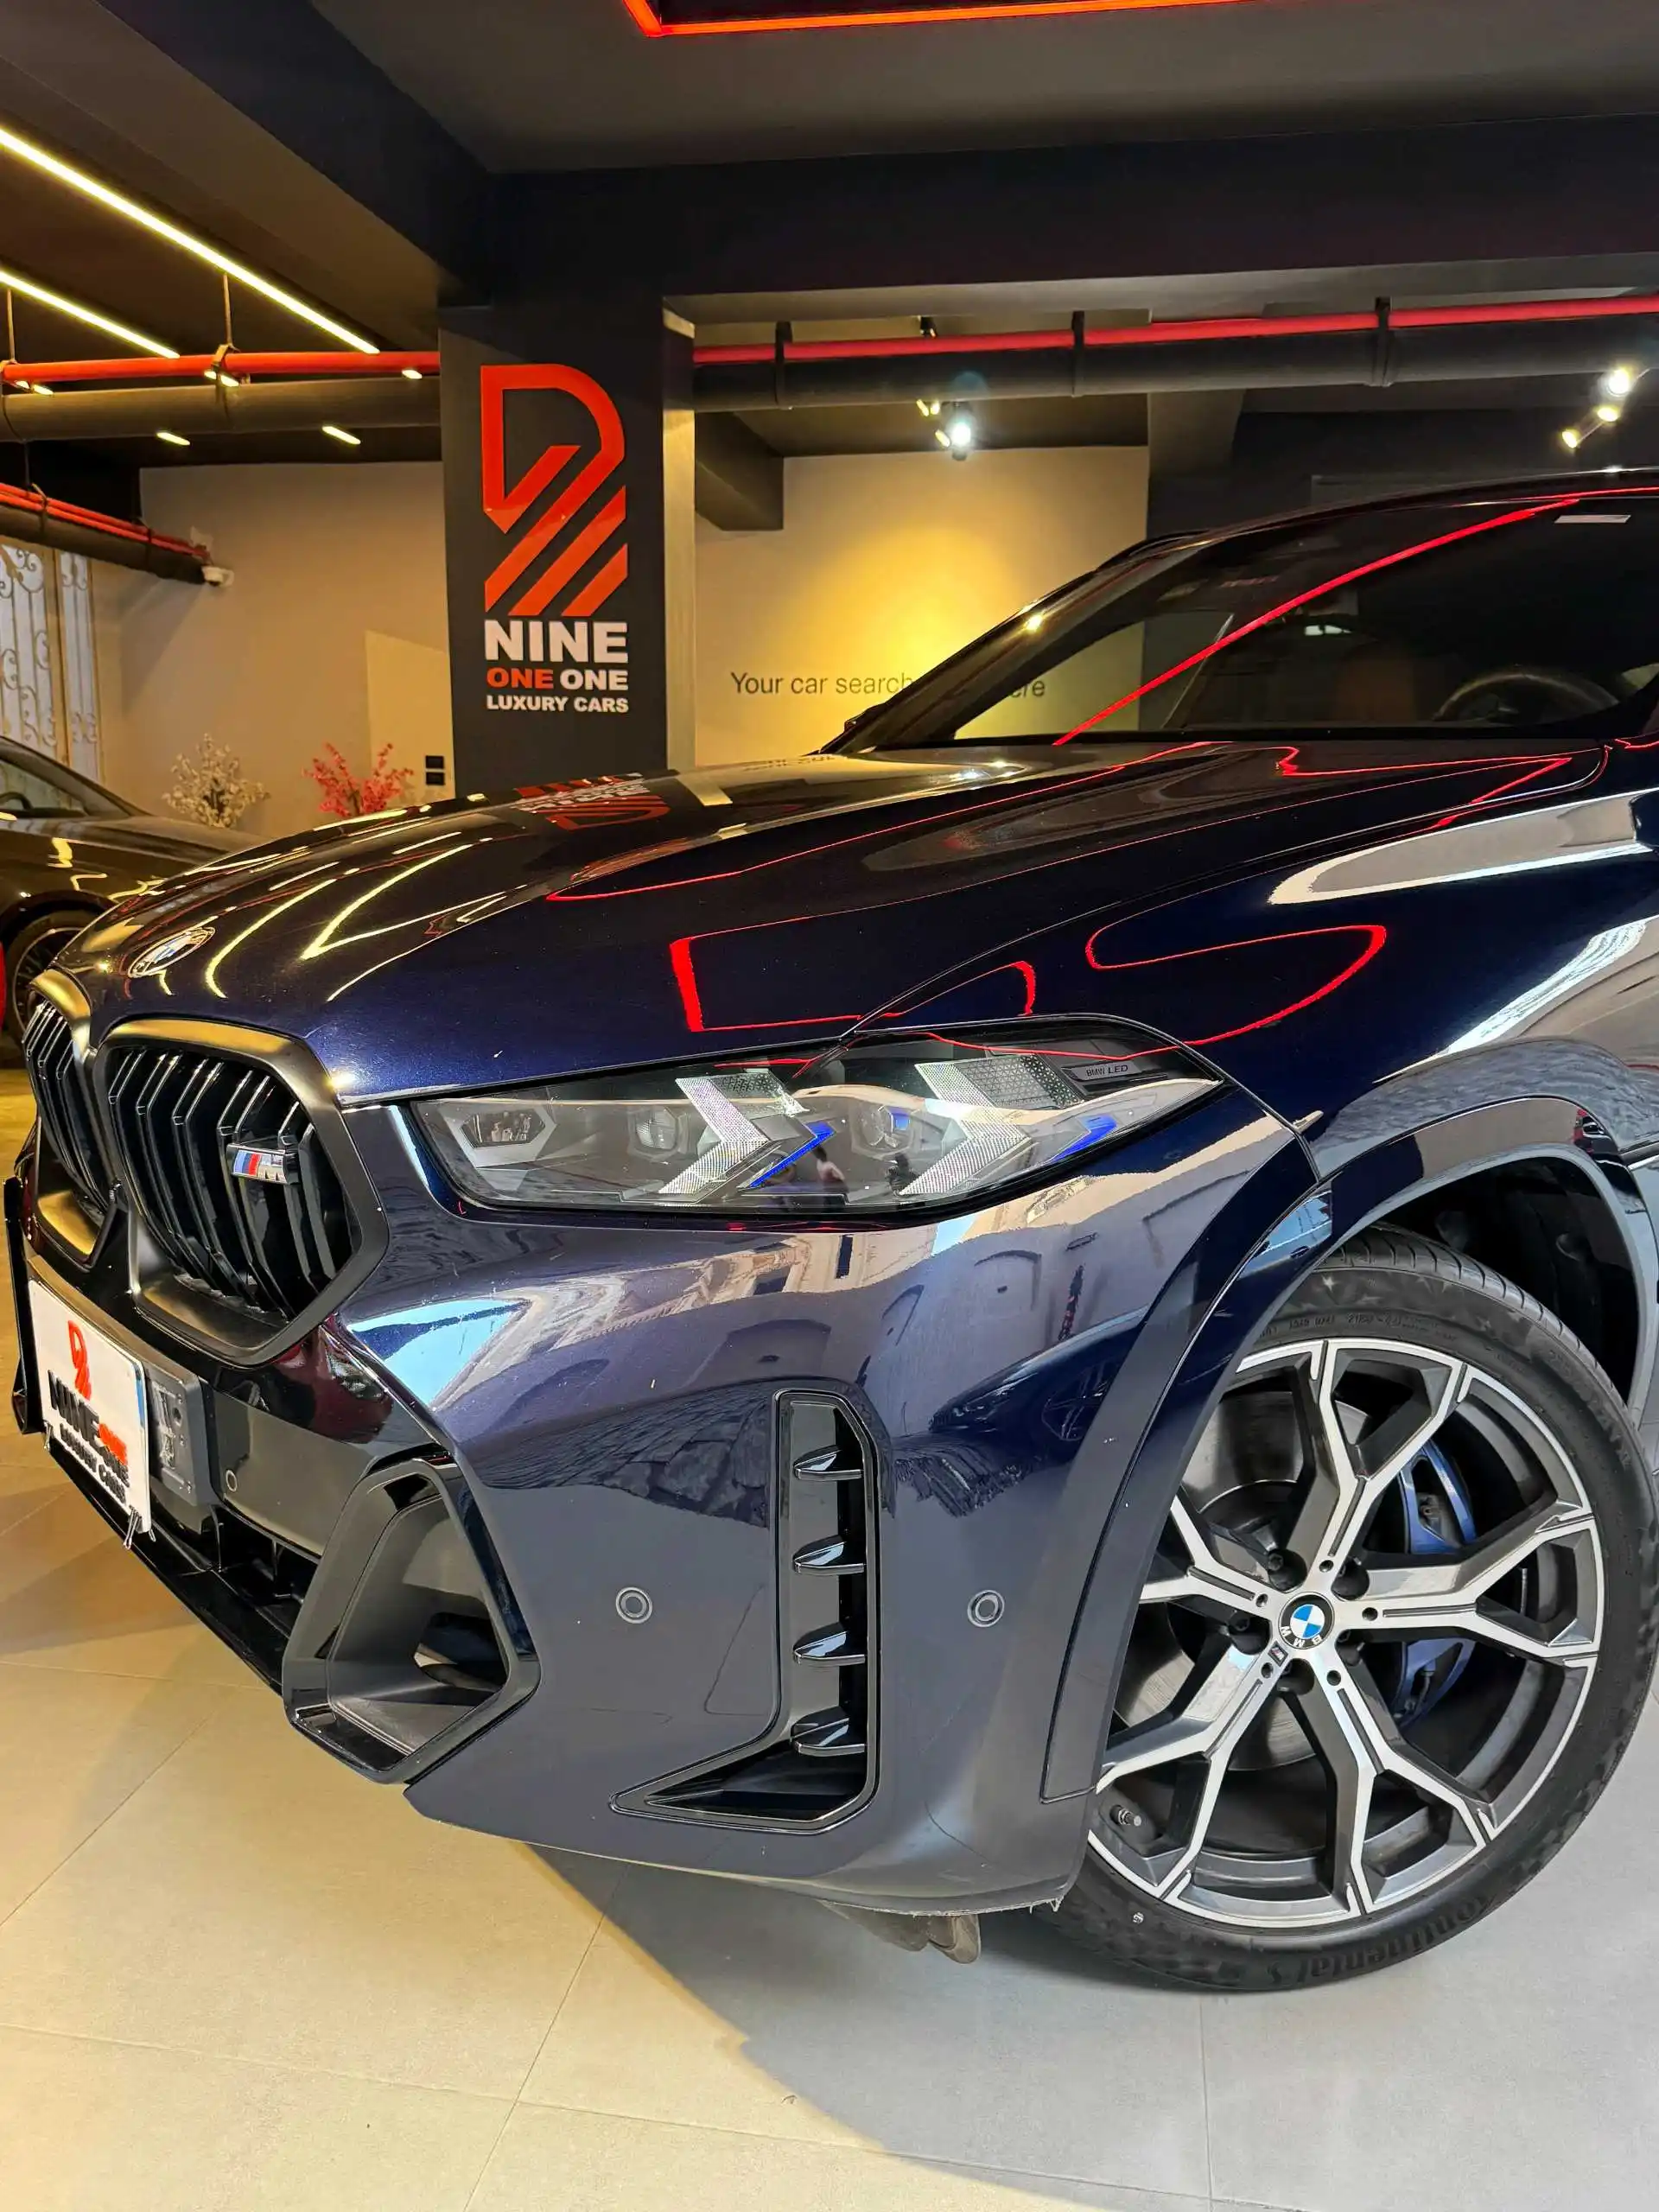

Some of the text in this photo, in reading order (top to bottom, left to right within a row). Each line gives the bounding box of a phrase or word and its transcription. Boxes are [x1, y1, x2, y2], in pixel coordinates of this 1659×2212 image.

[485, 620, 628, 664] NINE
[486, 667, 628, 690] ONE ONE
[731, 672, 784, 694] Your
[791, 677, 829, 694] car
[486, 695, 629, 713] LUXURY CARS
[1086, 1065, 1128, 1077] BMW LED
[1281, 1625, 1322, 1648] BMW
